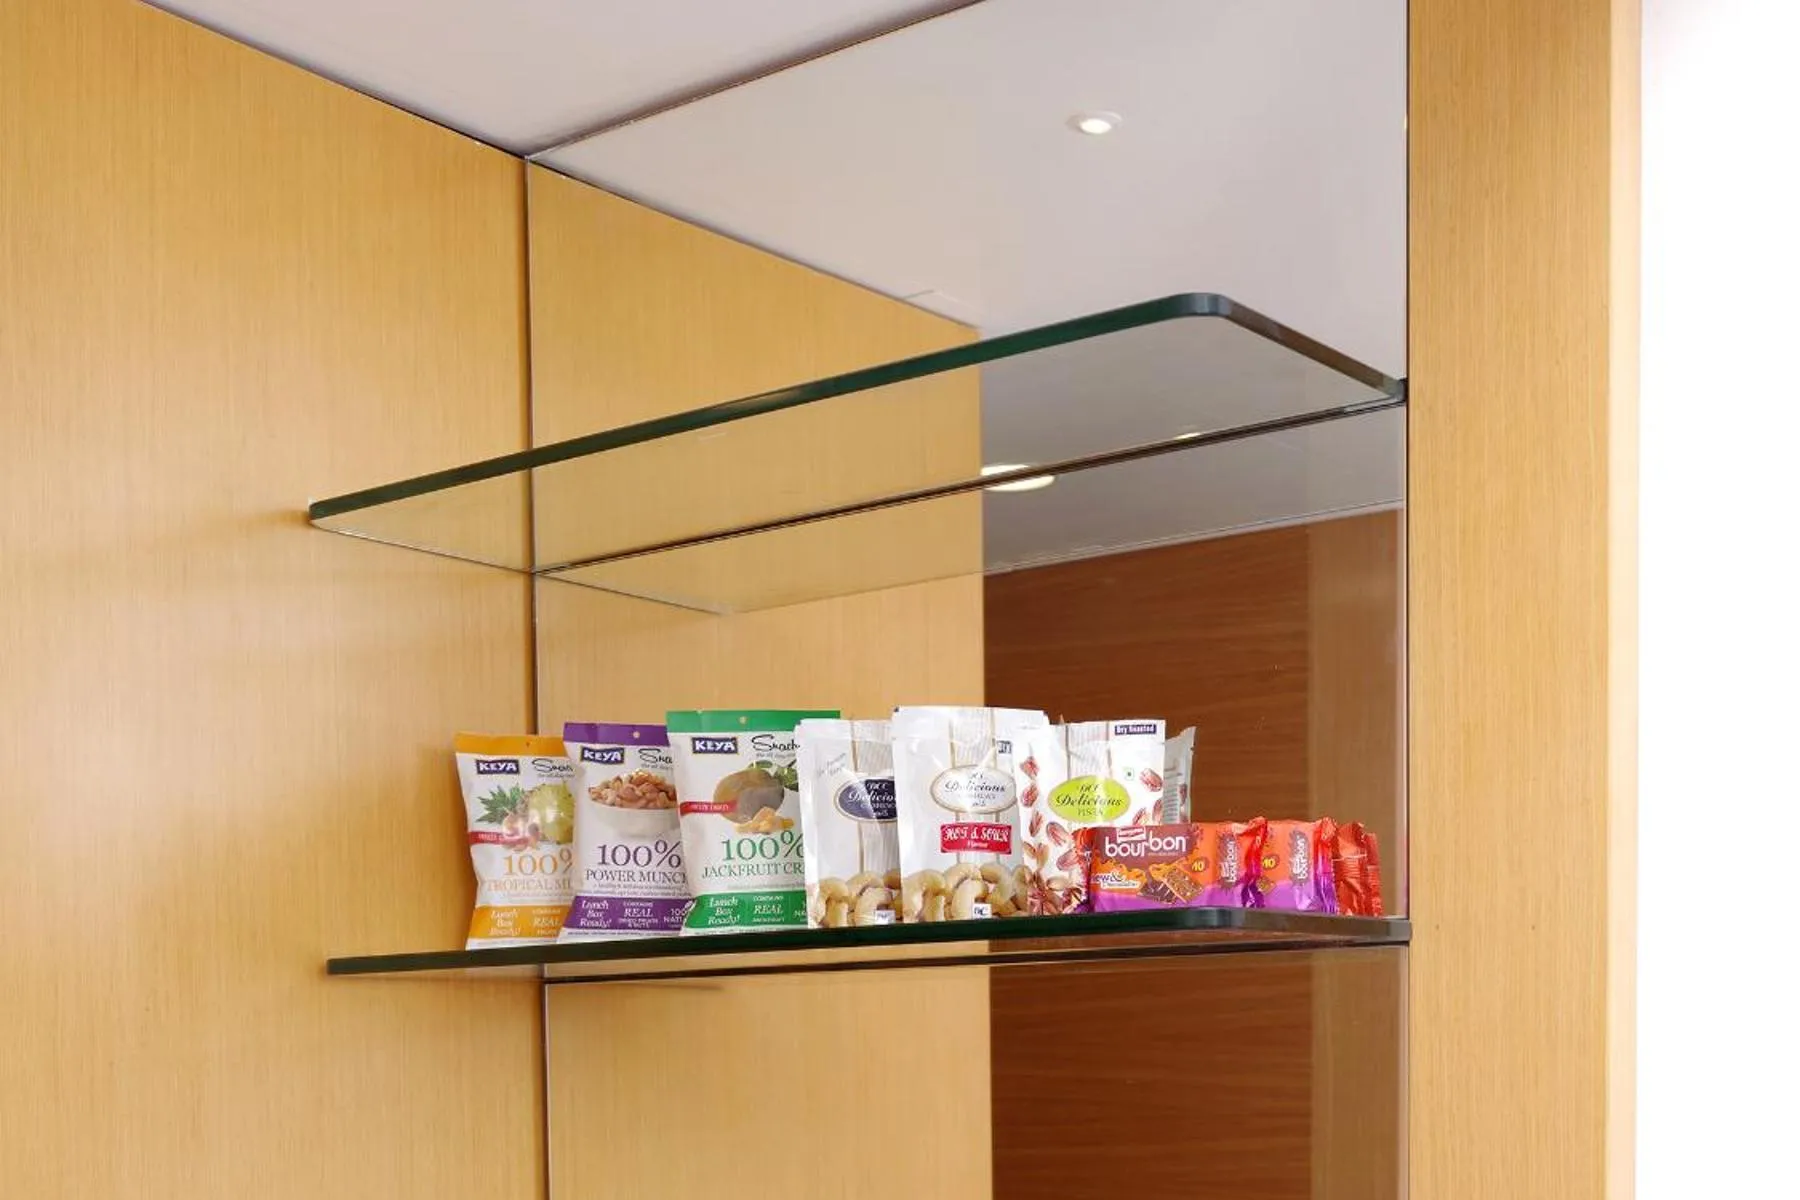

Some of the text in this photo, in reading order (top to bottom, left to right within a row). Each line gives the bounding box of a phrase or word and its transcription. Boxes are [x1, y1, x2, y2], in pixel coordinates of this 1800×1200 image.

[694, 740, 735, 751] KEYA
[583, 749, 621, 761] KEYA
[479, 760, 517, 771] KEYA
[1056, 793, 1122, 807] Delicious
[1105, 830, 1188, 857] bourbon
[597, 839, 681, 868] 100%
[586, 869, 636, 882] POWER
[702, 862, 804, 878] JACKFRUIT CR
[623, 908, 654, 918] REAL
